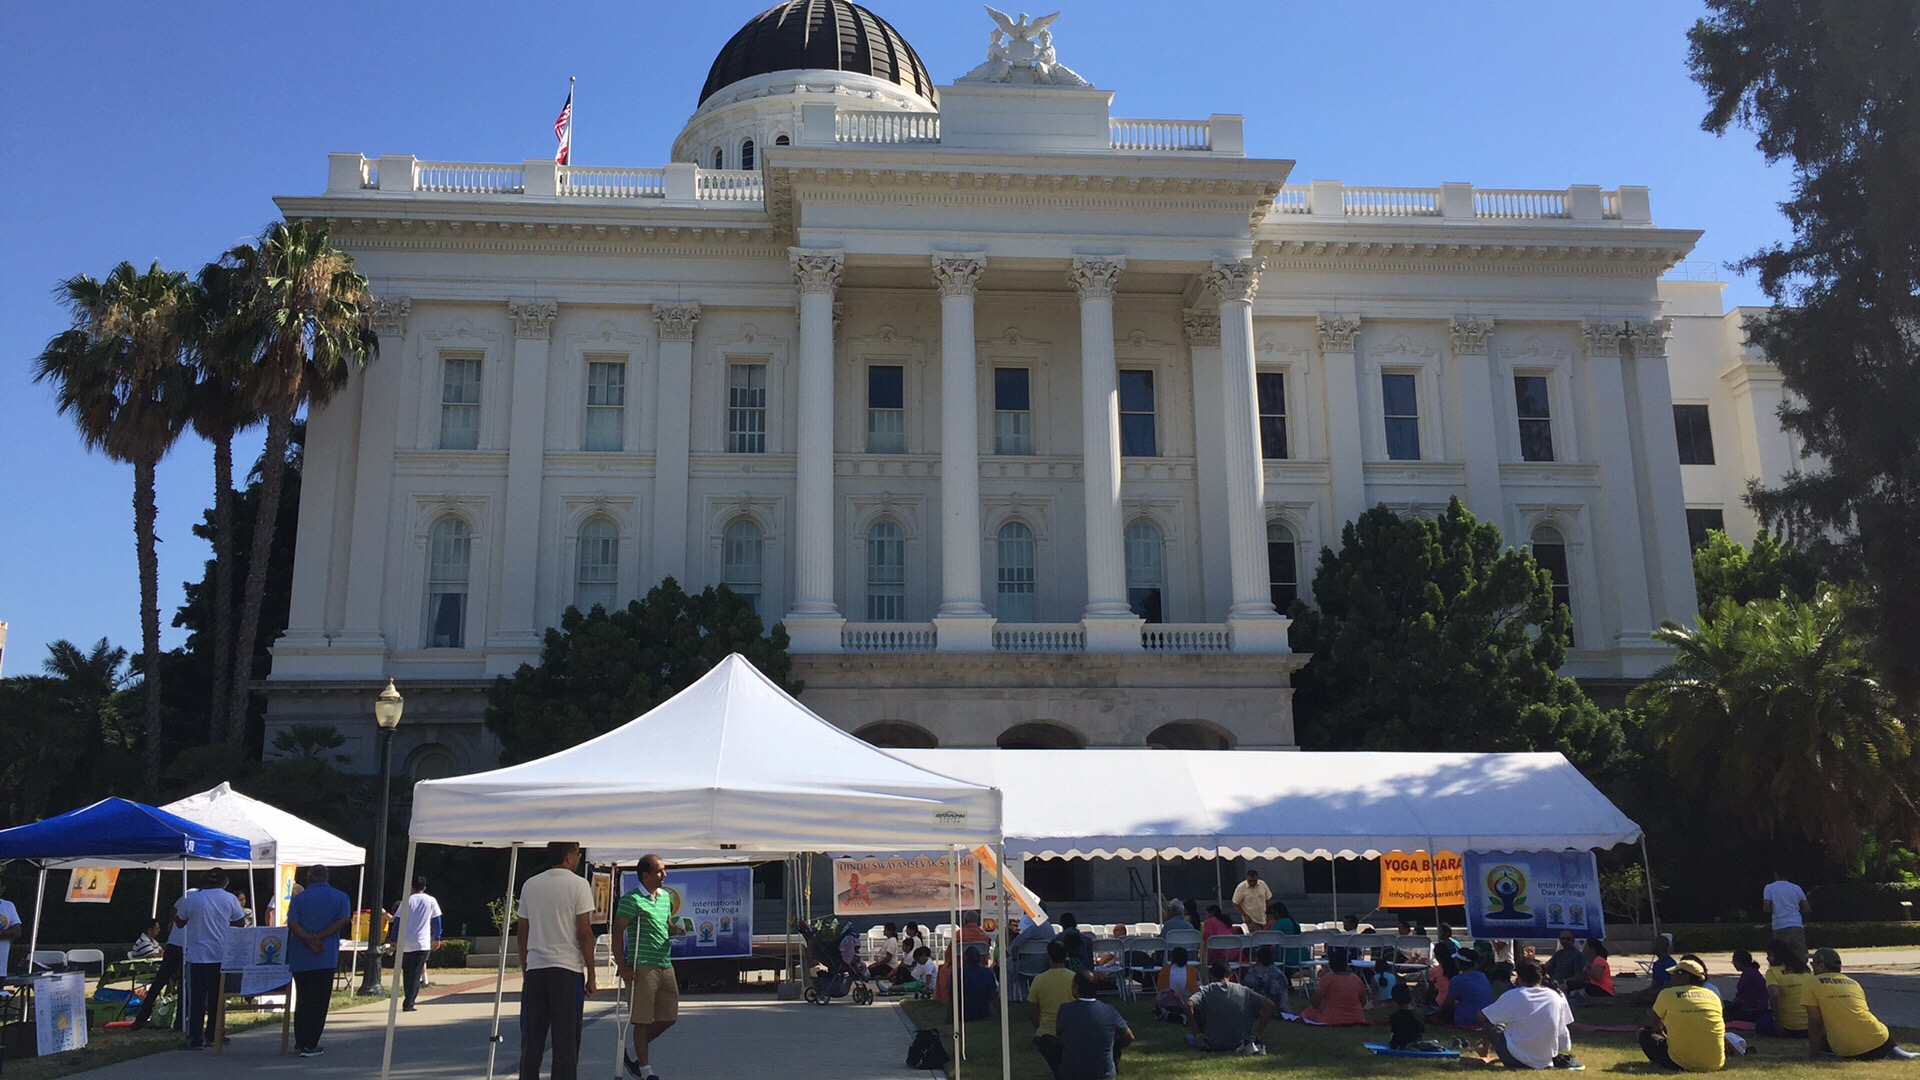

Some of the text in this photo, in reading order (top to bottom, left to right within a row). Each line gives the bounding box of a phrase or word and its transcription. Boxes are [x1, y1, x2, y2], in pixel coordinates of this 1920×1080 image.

[840, 861, 869, 870] HINDU
[872, 860, 937, 870] SWAYAMSEVAK
[1385, 859, 1418, 871] YOGA
[1538, 881, 1588, 889] International
[1541, 888, 1586, 897] Day of Yoga
[692, 899, 742, 908] International
[695, 907, 710, 915] Day
[721, 906, 739, 914] Yoga
